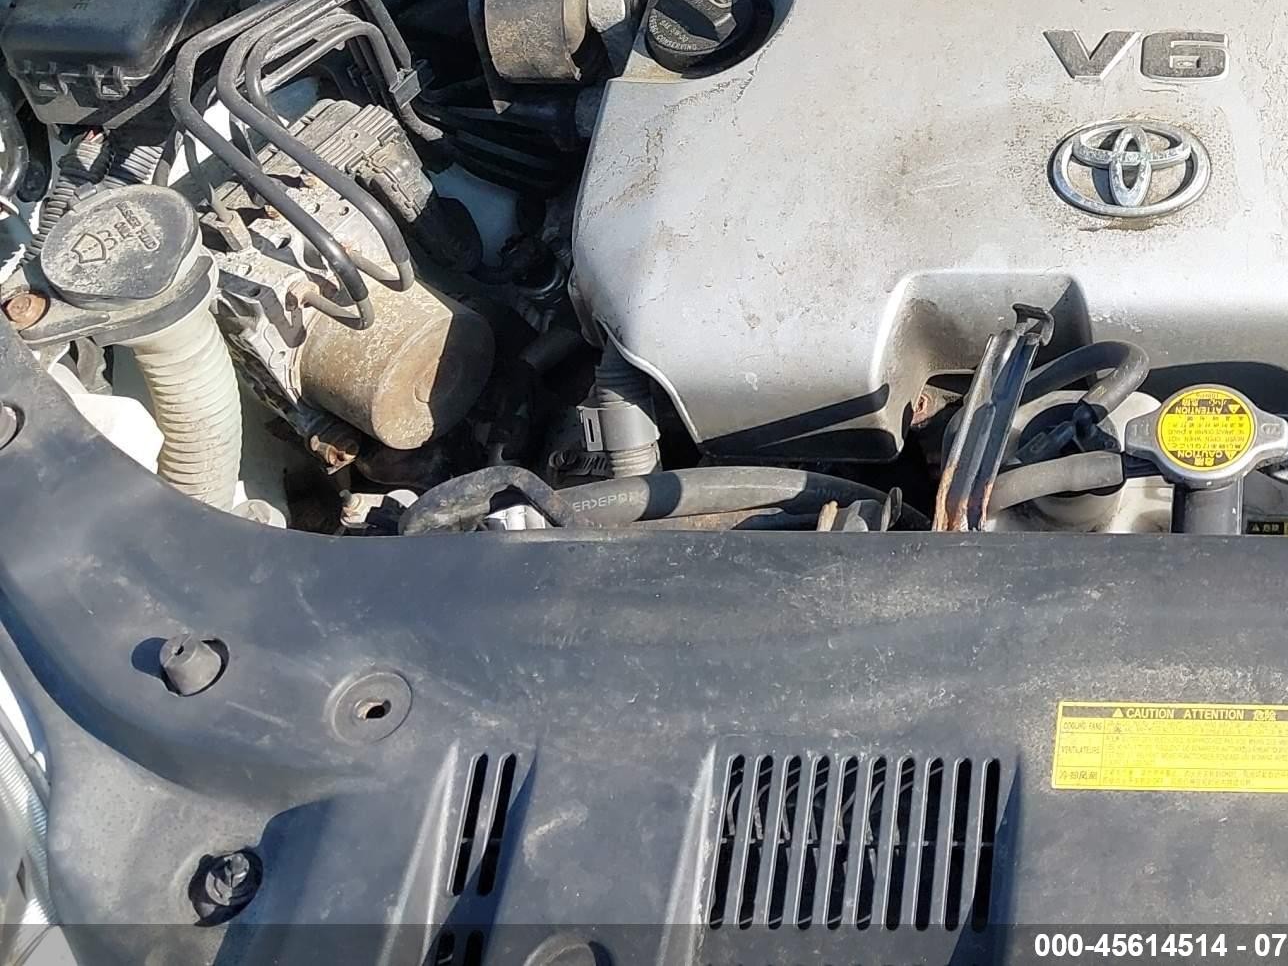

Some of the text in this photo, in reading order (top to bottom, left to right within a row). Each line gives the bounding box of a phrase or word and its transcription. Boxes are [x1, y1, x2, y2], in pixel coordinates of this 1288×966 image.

[1042, 29, 1230, 83] V6
[1175, 406, 1222, 414] ATTENTION
[1177, 450, 1223, 458] CAUTION
[1126, 708, 1175, 719] CAUTION
[1183, 709, 1245, 720] ATTENTION
